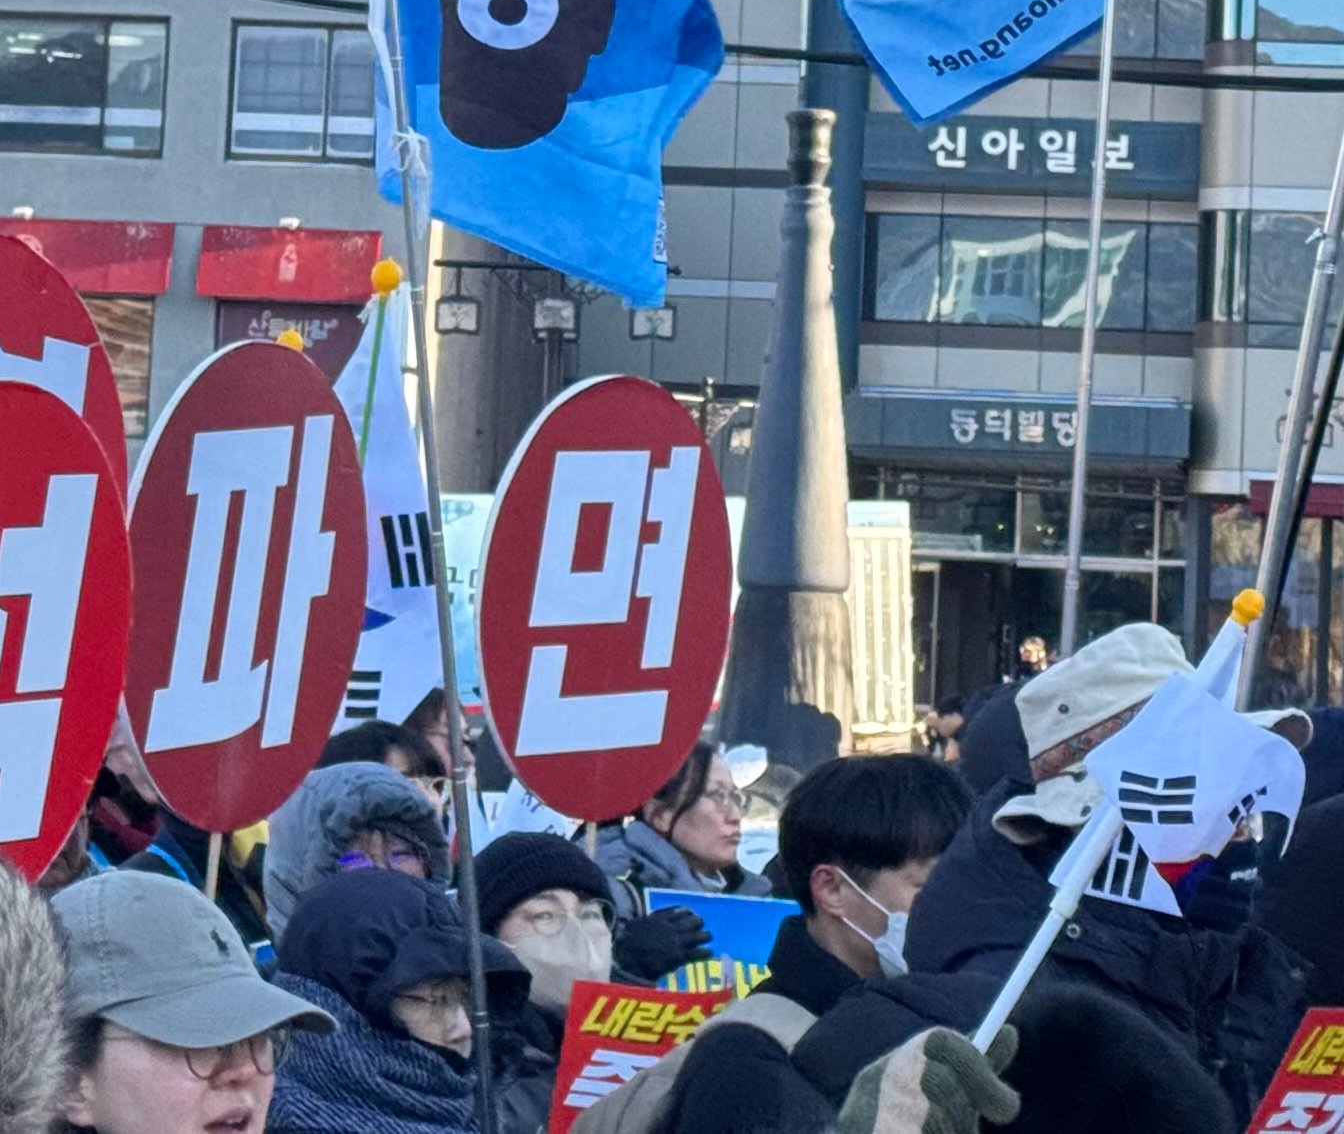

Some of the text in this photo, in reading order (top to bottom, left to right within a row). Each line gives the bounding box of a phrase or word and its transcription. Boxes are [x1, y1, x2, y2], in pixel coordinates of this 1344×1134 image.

[927, 125, 1135, 173] 신아일보
[145, 414, 336, 753] 파
[515, 447, 702, 757] 면
